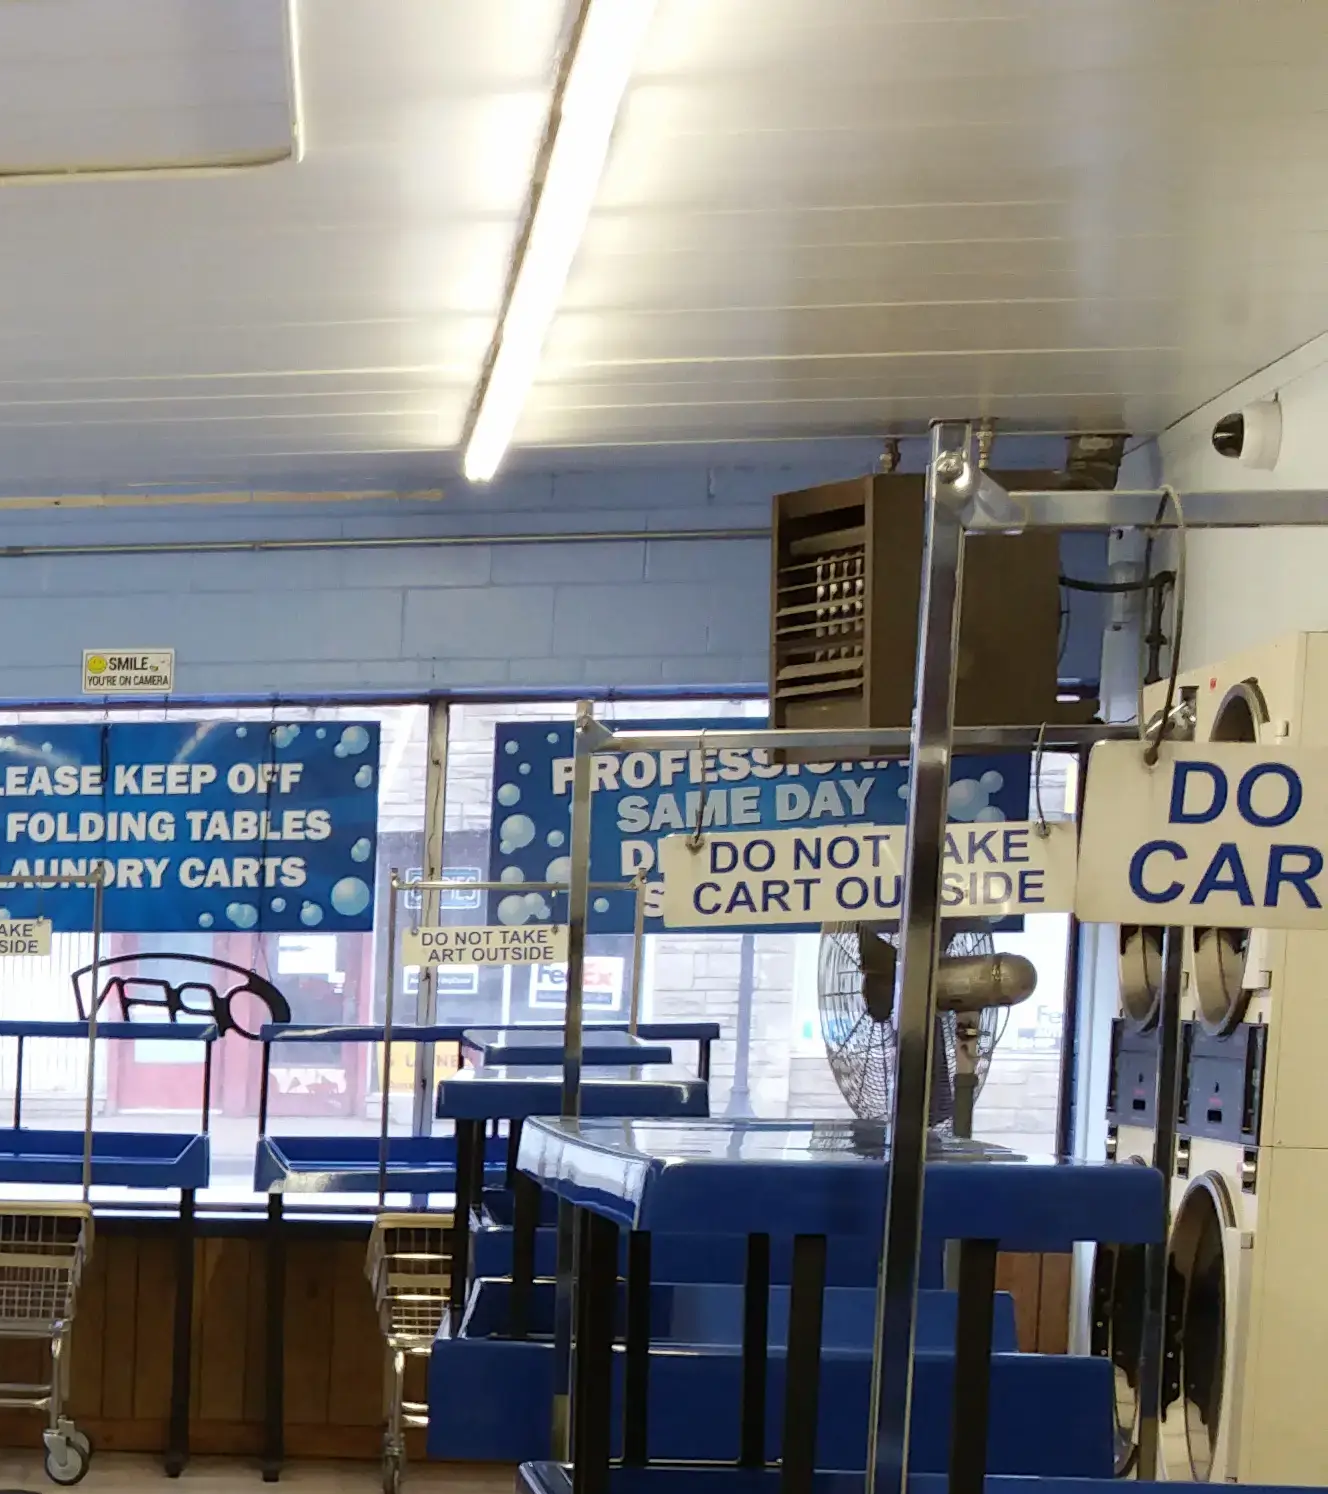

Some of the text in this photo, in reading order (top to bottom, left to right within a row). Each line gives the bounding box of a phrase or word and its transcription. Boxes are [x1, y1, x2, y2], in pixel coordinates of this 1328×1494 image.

[109, 657, 148, 671] SMILE
[88, 675, 168, 686] YOU'RE ON CAMERA
[114, 764, 217, 795] KEEP
[227, 763, 304, 794] OFF
[1168, 760, 1303, 827] DO
[617, 777, 876, 833] SAME DAY
[6, 811, 176, 843] FOLDING
[186, 810, 332, 842] TABLES
[710, 829, 1029, 874] DO NOT AKE
[179, 856, 307, 888] CARTS
[1129, 839, 1324, 909] CAR
[410, 876, 476, 901] CPIES
[693, 878, 821, 914] CART
[836, 869, 1044, 911] OUSIDE
[421, 929, 548, 946] DO NOT TAKE
[471, 946, 553, 962] OUTSIDE
[538, 965, 612, 986] FeEx
